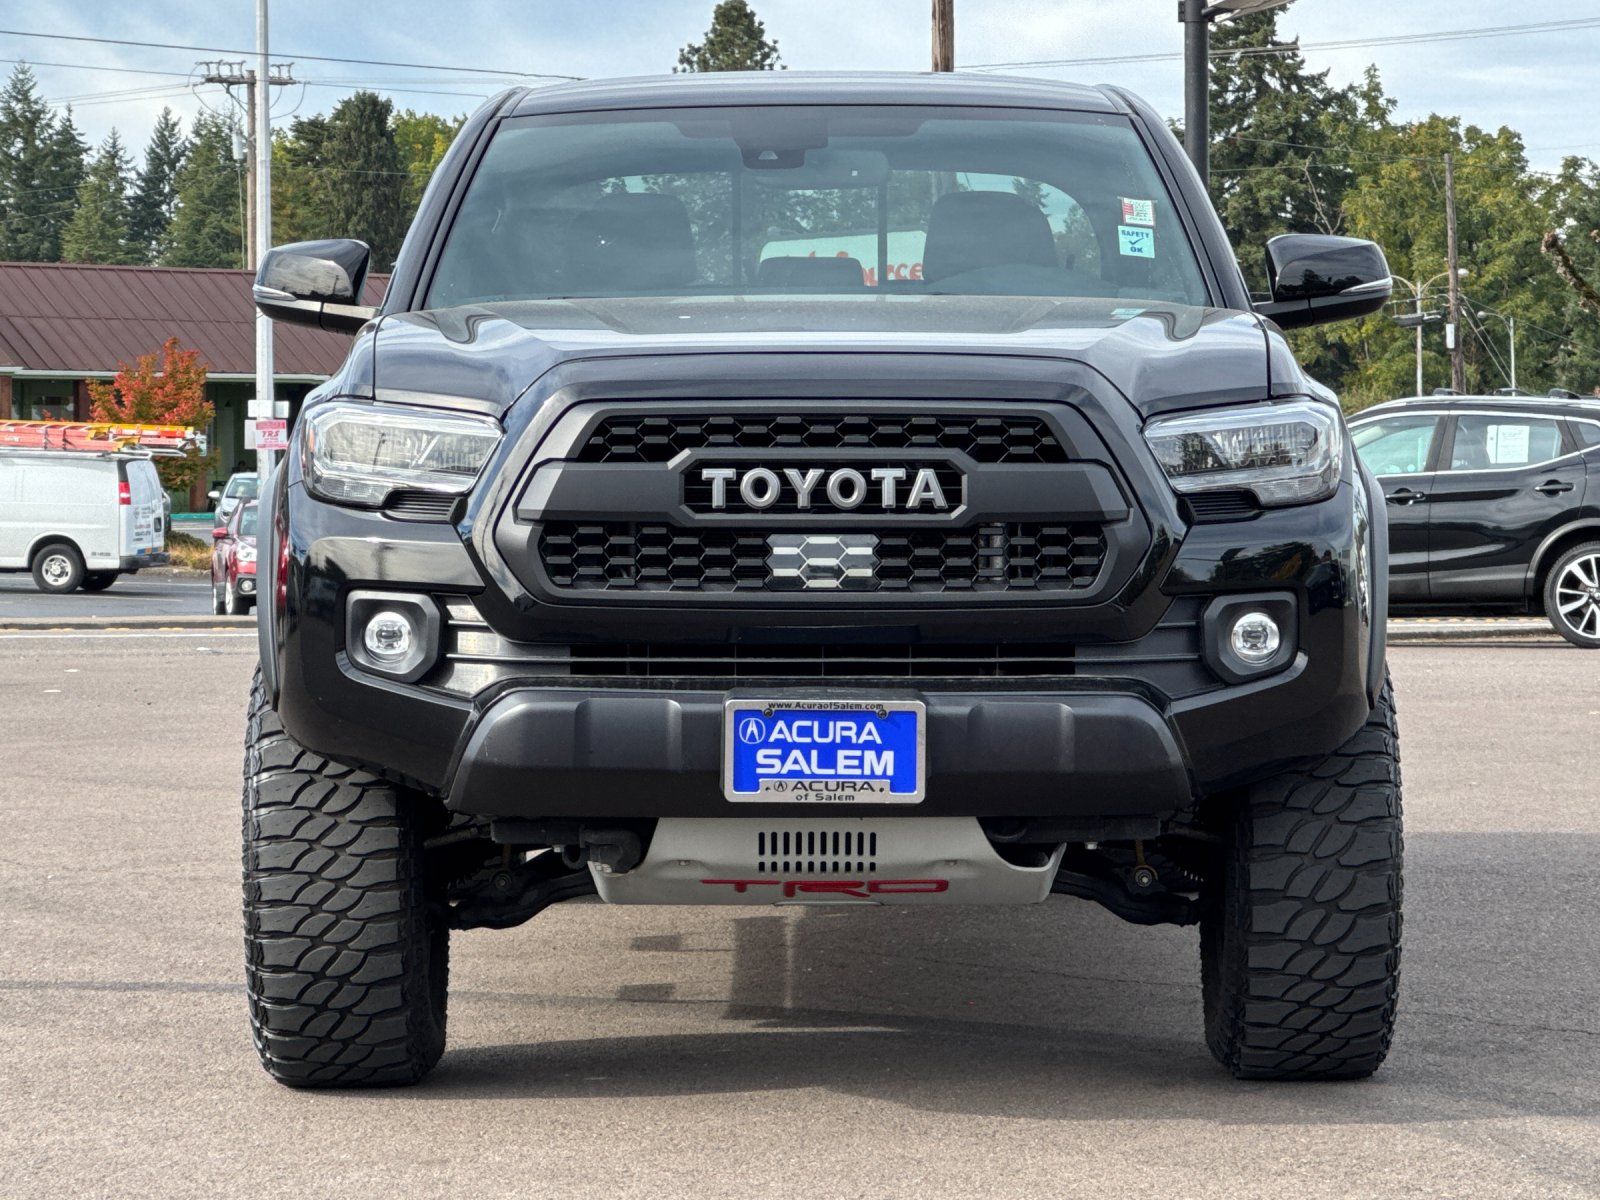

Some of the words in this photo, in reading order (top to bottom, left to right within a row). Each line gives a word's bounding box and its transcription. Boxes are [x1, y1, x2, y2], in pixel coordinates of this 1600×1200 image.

[1121, 229, 1150, 238] SAFETY
[701, 467, 949, 510] TOYOTA
[768, 720, 883, 744] ACURA
[755, 748, 895, 776] SALEM
[791, 780, 876, 793] ACURA
[795, 793, 809, 802] of
[815, 793, 855, 802] Salem
[700, 879, 949, 897] TRD
